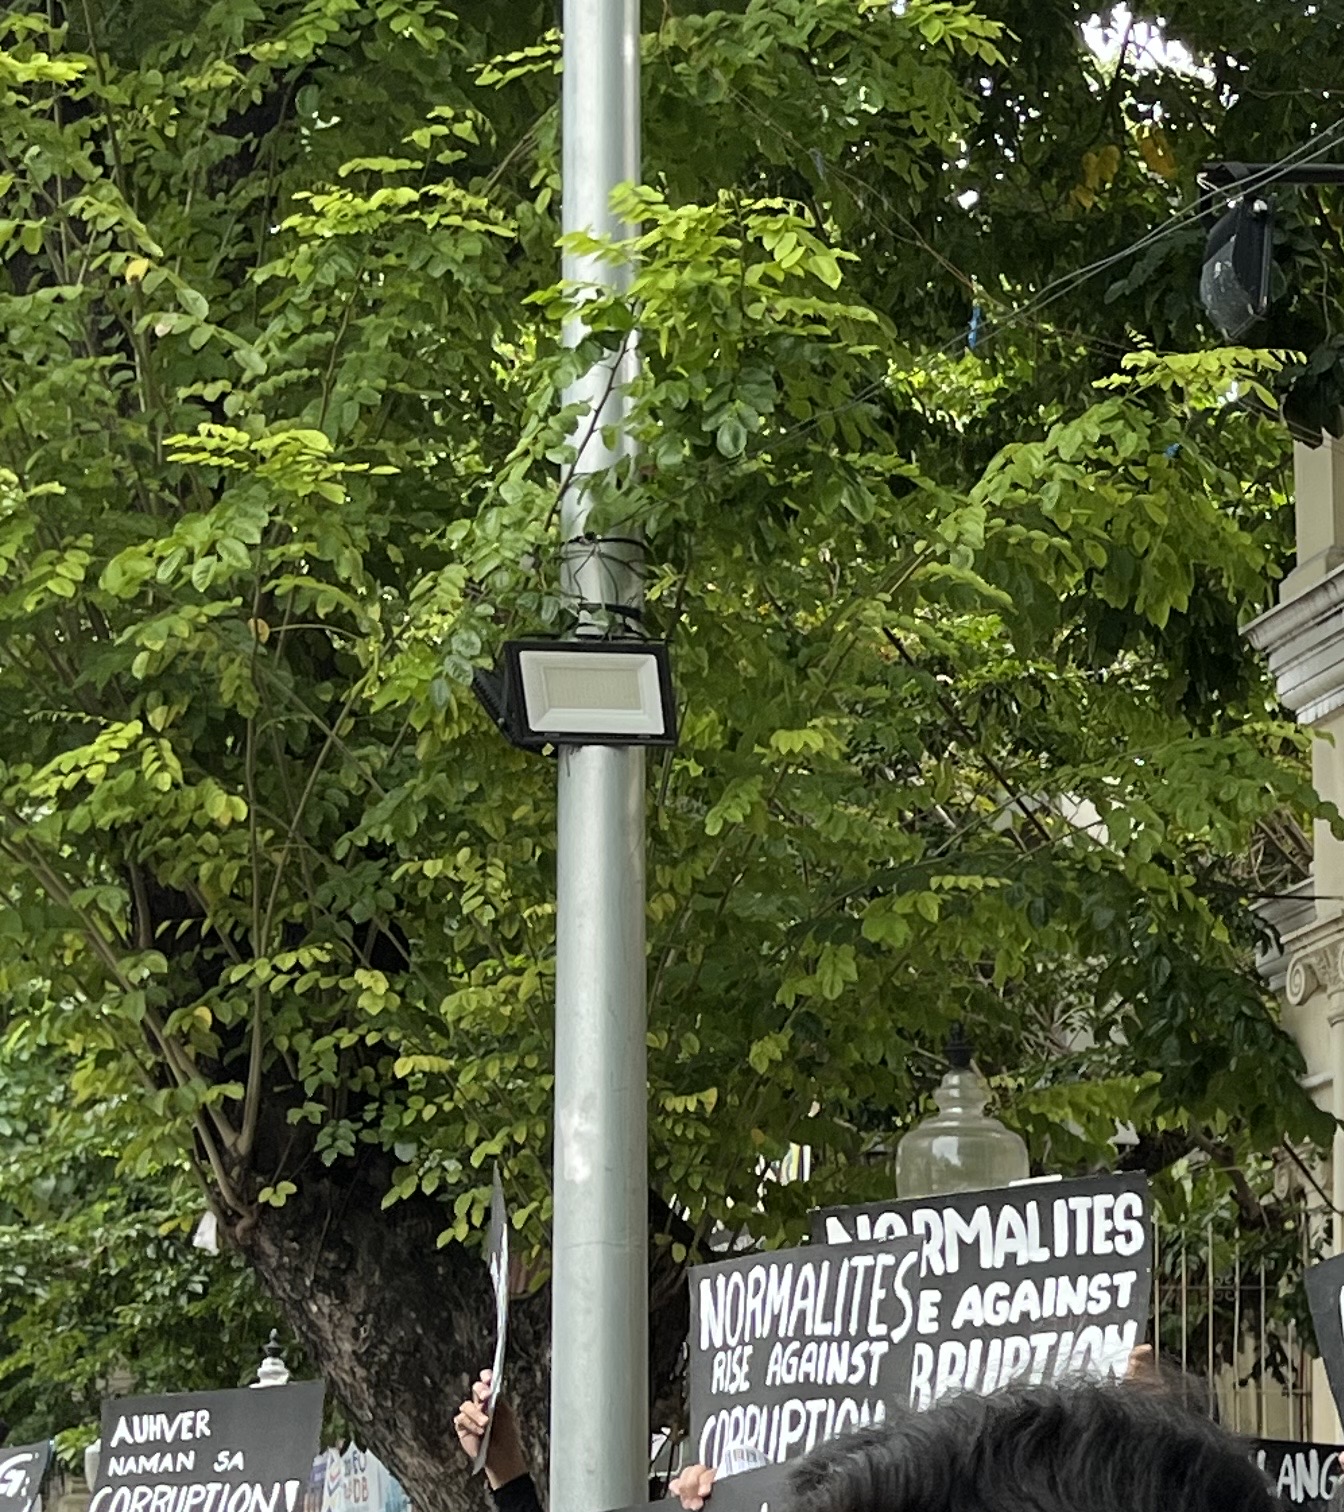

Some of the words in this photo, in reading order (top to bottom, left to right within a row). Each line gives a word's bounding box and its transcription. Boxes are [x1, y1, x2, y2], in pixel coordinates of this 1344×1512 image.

[699, 1250, 919, 1350] NORMALITES
[951, 1271, 1137, 1330] AGAINST
[711, 1344, 751, 1395] RISE
[765, 1340, 890, 1388] AGAINST
[108, 1450, 196, 1478] NAMAN
[213, 1450, 245, 1472] SA
